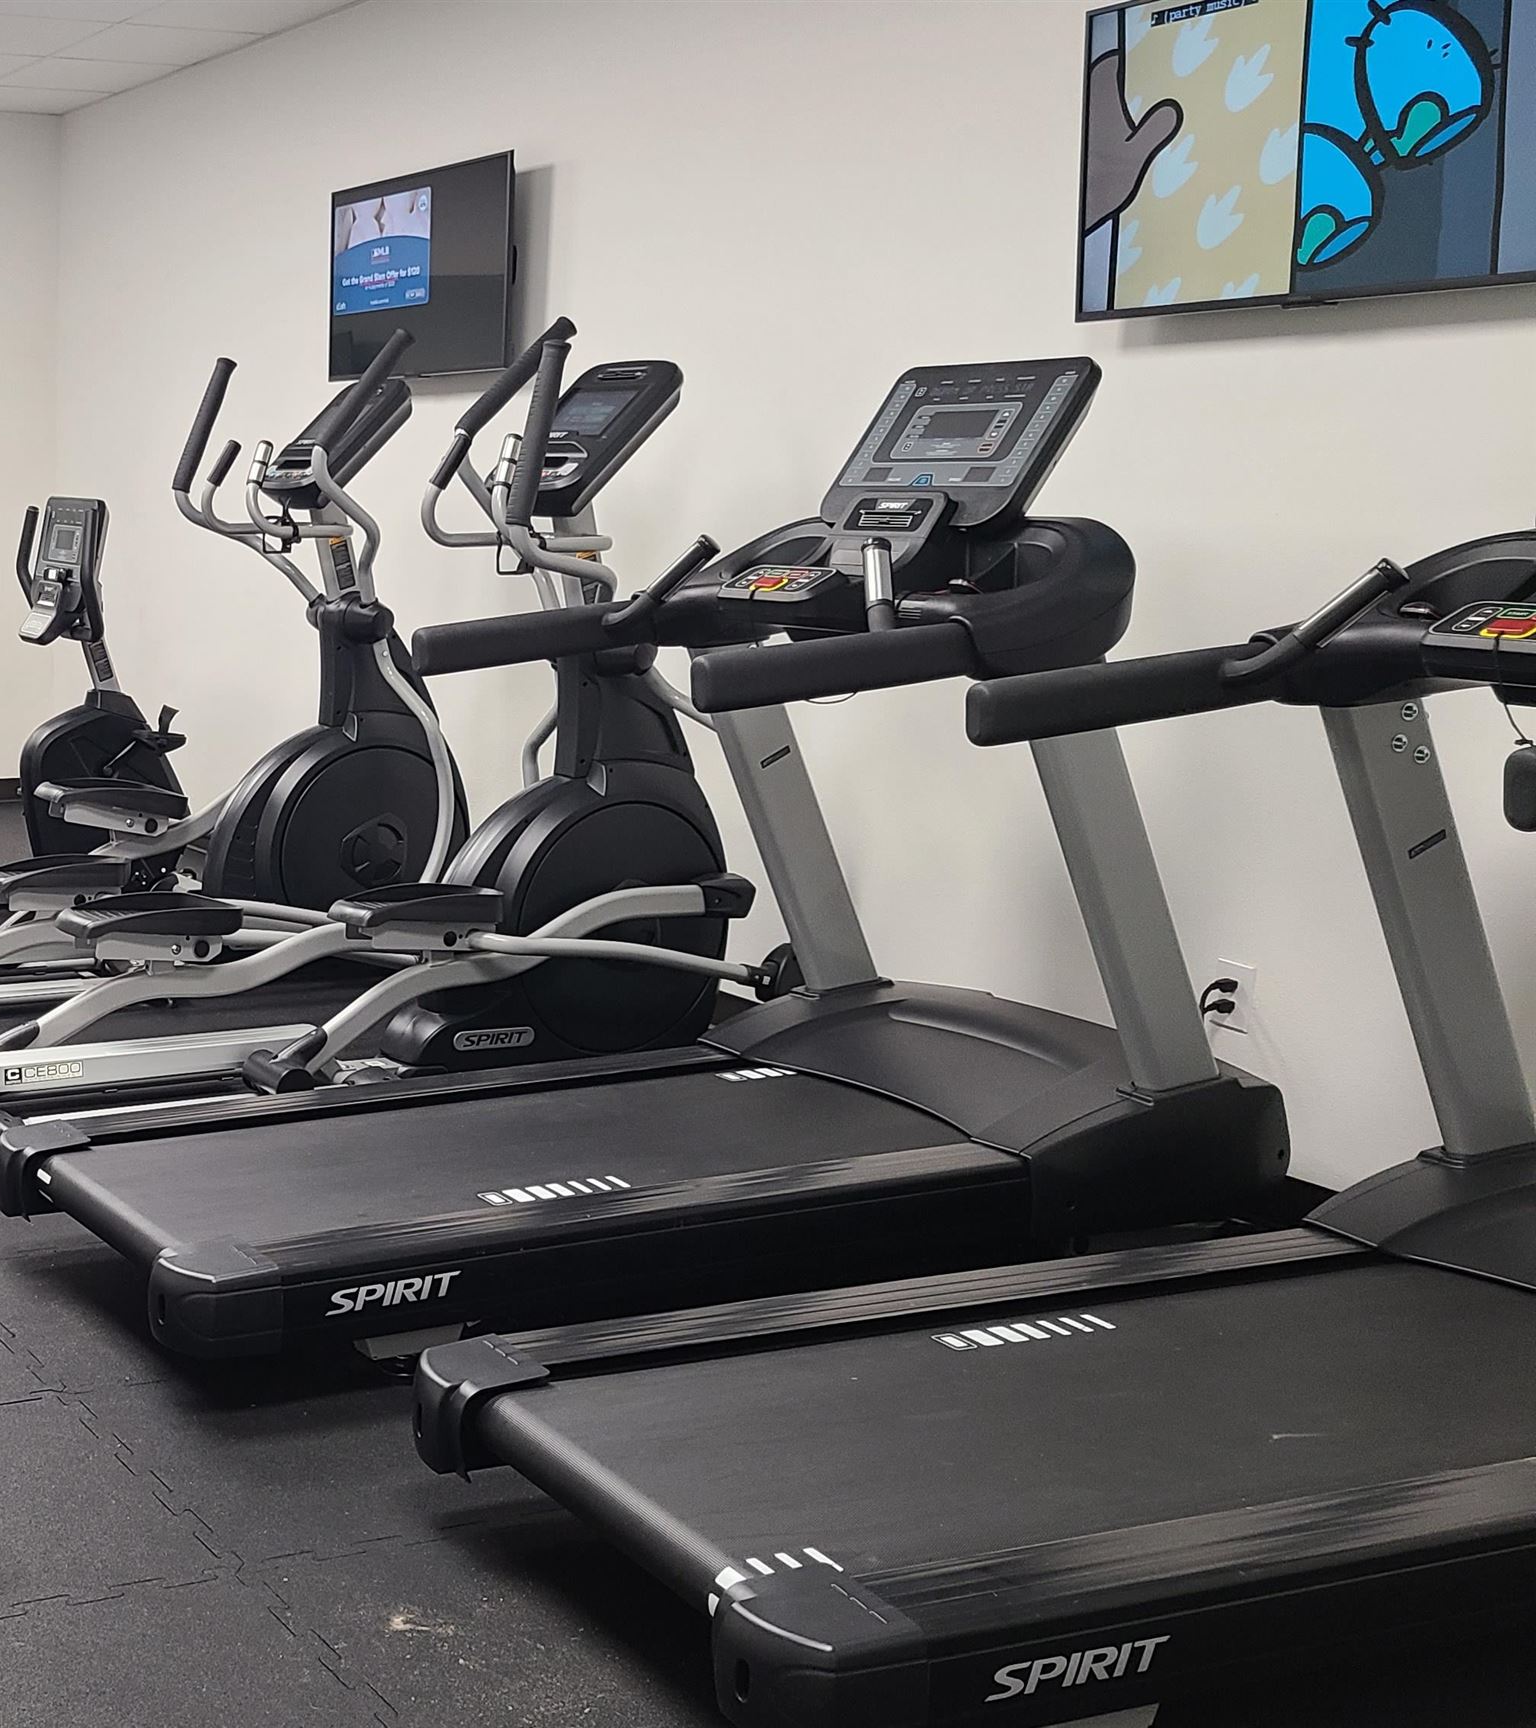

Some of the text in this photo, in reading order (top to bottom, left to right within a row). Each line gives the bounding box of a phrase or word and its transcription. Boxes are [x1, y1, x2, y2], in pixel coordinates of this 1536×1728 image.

[1164, 5, 1202, 24] (party
[463, 1031, 529, 1048] SPIRIT
[24, 1062, 81, 1079] CE800
[324, 1270, 462, 1317] SPIRIT
[983, 1634, 1172, 1703] SPIRIT
